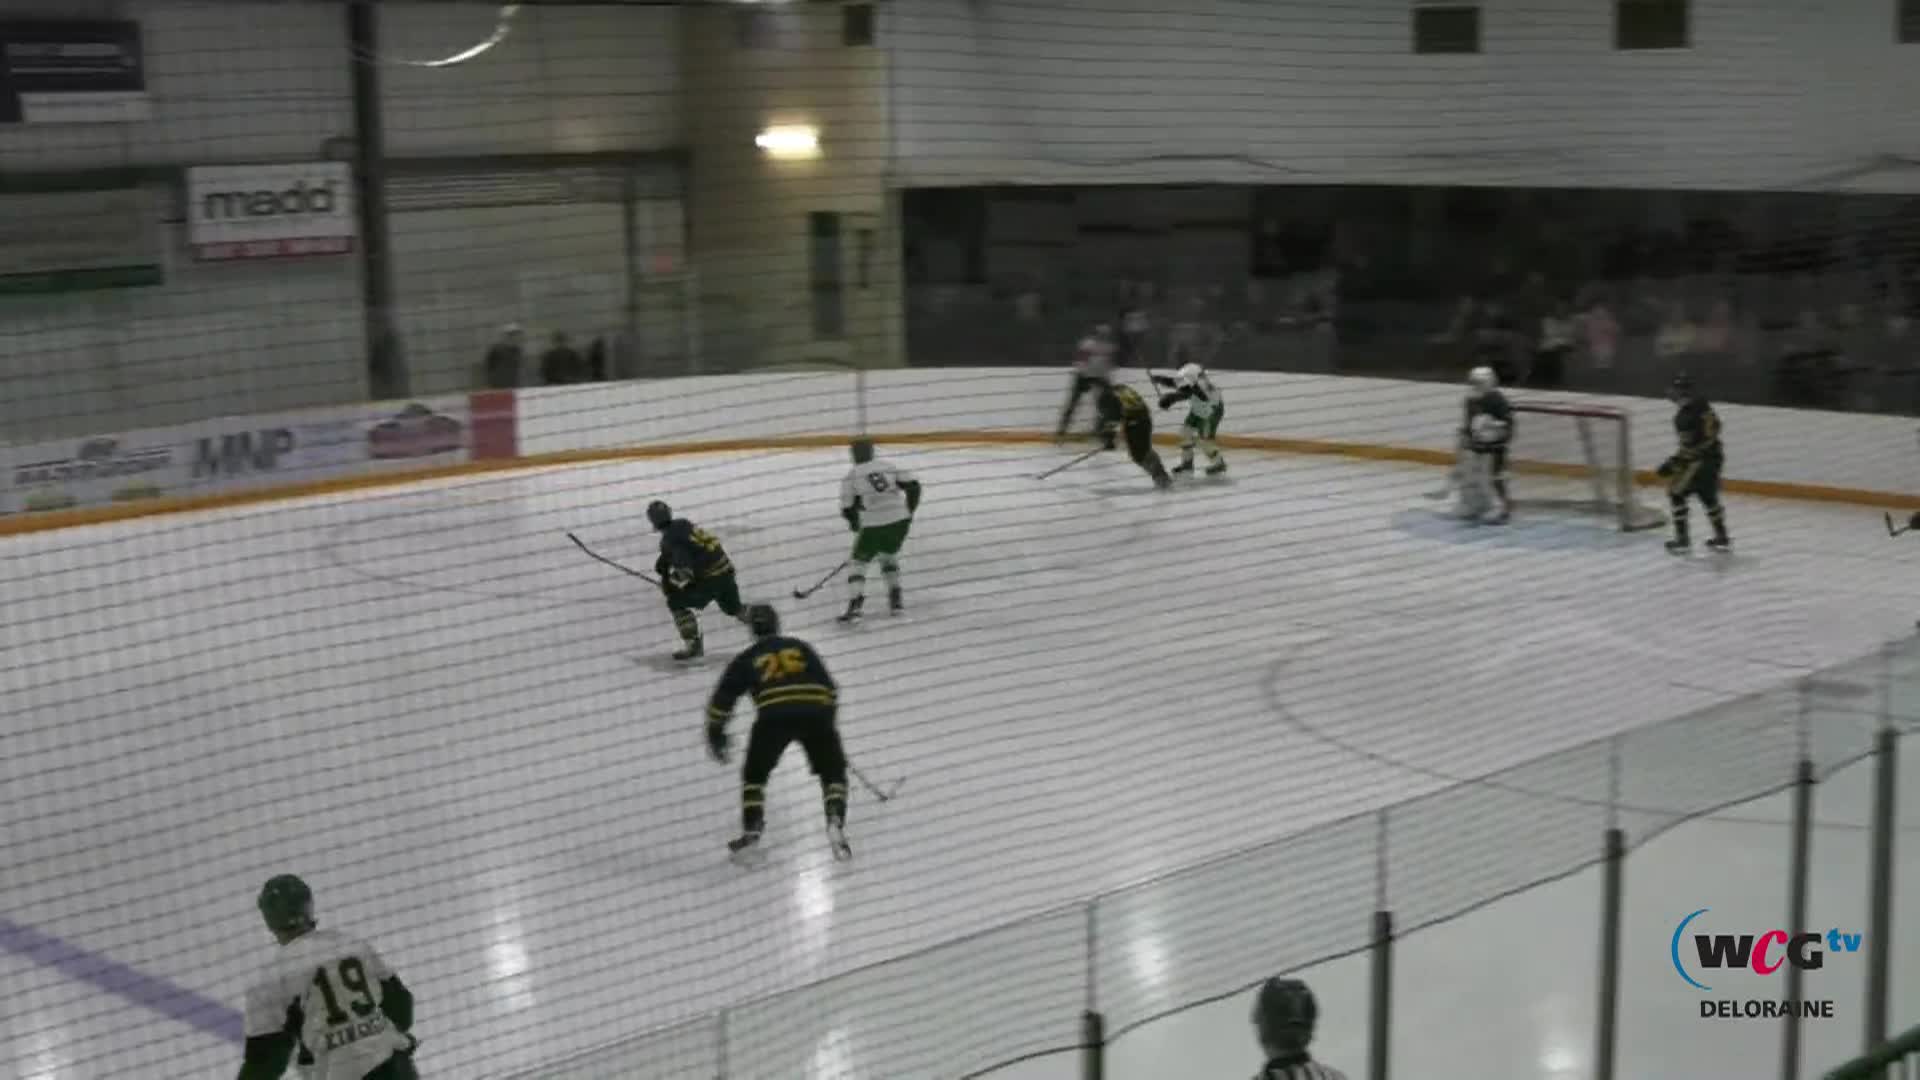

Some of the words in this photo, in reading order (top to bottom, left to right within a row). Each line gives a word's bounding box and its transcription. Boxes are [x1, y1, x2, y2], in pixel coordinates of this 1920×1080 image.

[204, 180, 336, 219] madd
[193, 428, 295, 479] MNP
[753, 647, 809, 681] 26
[312, 956, 376, 1024] 19
